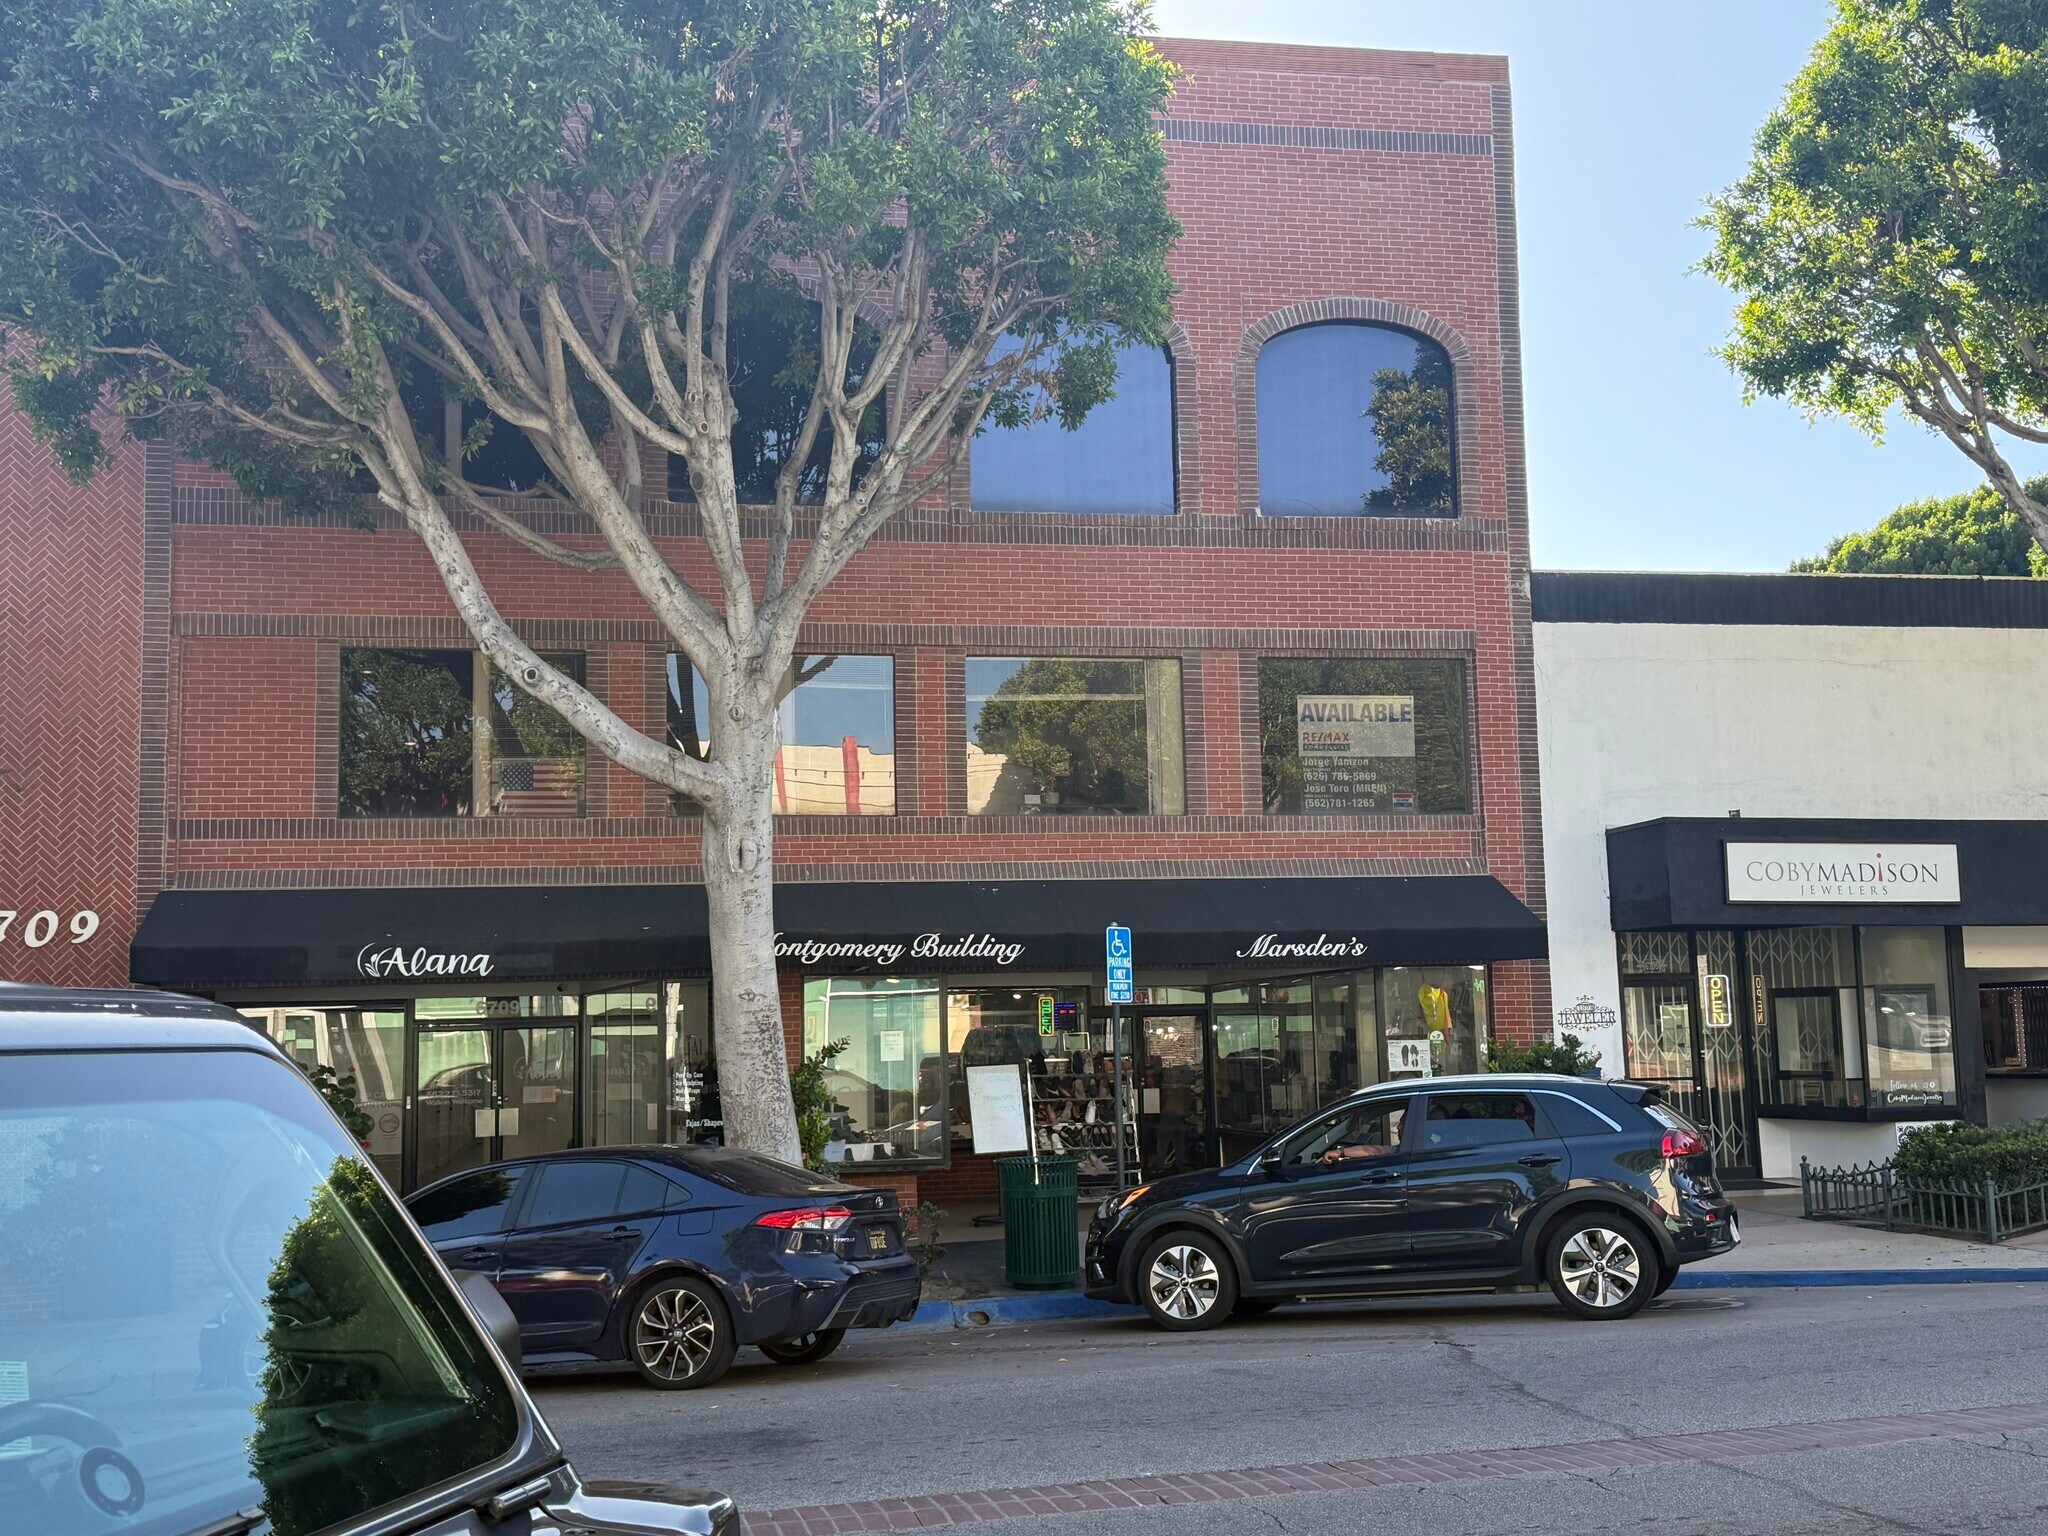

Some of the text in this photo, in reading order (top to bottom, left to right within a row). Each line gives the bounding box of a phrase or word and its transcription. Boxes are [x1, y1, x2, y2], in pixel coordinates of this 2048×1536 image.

[1300, 703, 1412, 722] AVAILABLE
[1302, 732, 1349, 742] RE/MAX
[1302, 757, 1329, 767] Jorge
[1303, 772, 1328, 782] (626)
[1304, 784, 1326, 793] Jose
[1327, 784, 1349, 793] Toro
[1305, 798, 1375, 808] (562)781-1265
[1801, 885, 1888, 895] JEWELERS
[773, 932, 1025, 964] ontgomery Building
[1237, 934, 1368, 958] Marsden's
[380, 947, 494, 977] Alana
[1108, 957, 1130, 967] PARKING
[1113, 968, 1127, 980] ONLY
[1110, 991, 1119, 999] FINE
[1710, 977, 1724, 1023] OPEN
[476, 1000, 520, 1014] 6709
[1042, 999, 1052, 1034] OPEN
[1558, 1010, 1616, 1025] JEWELER
